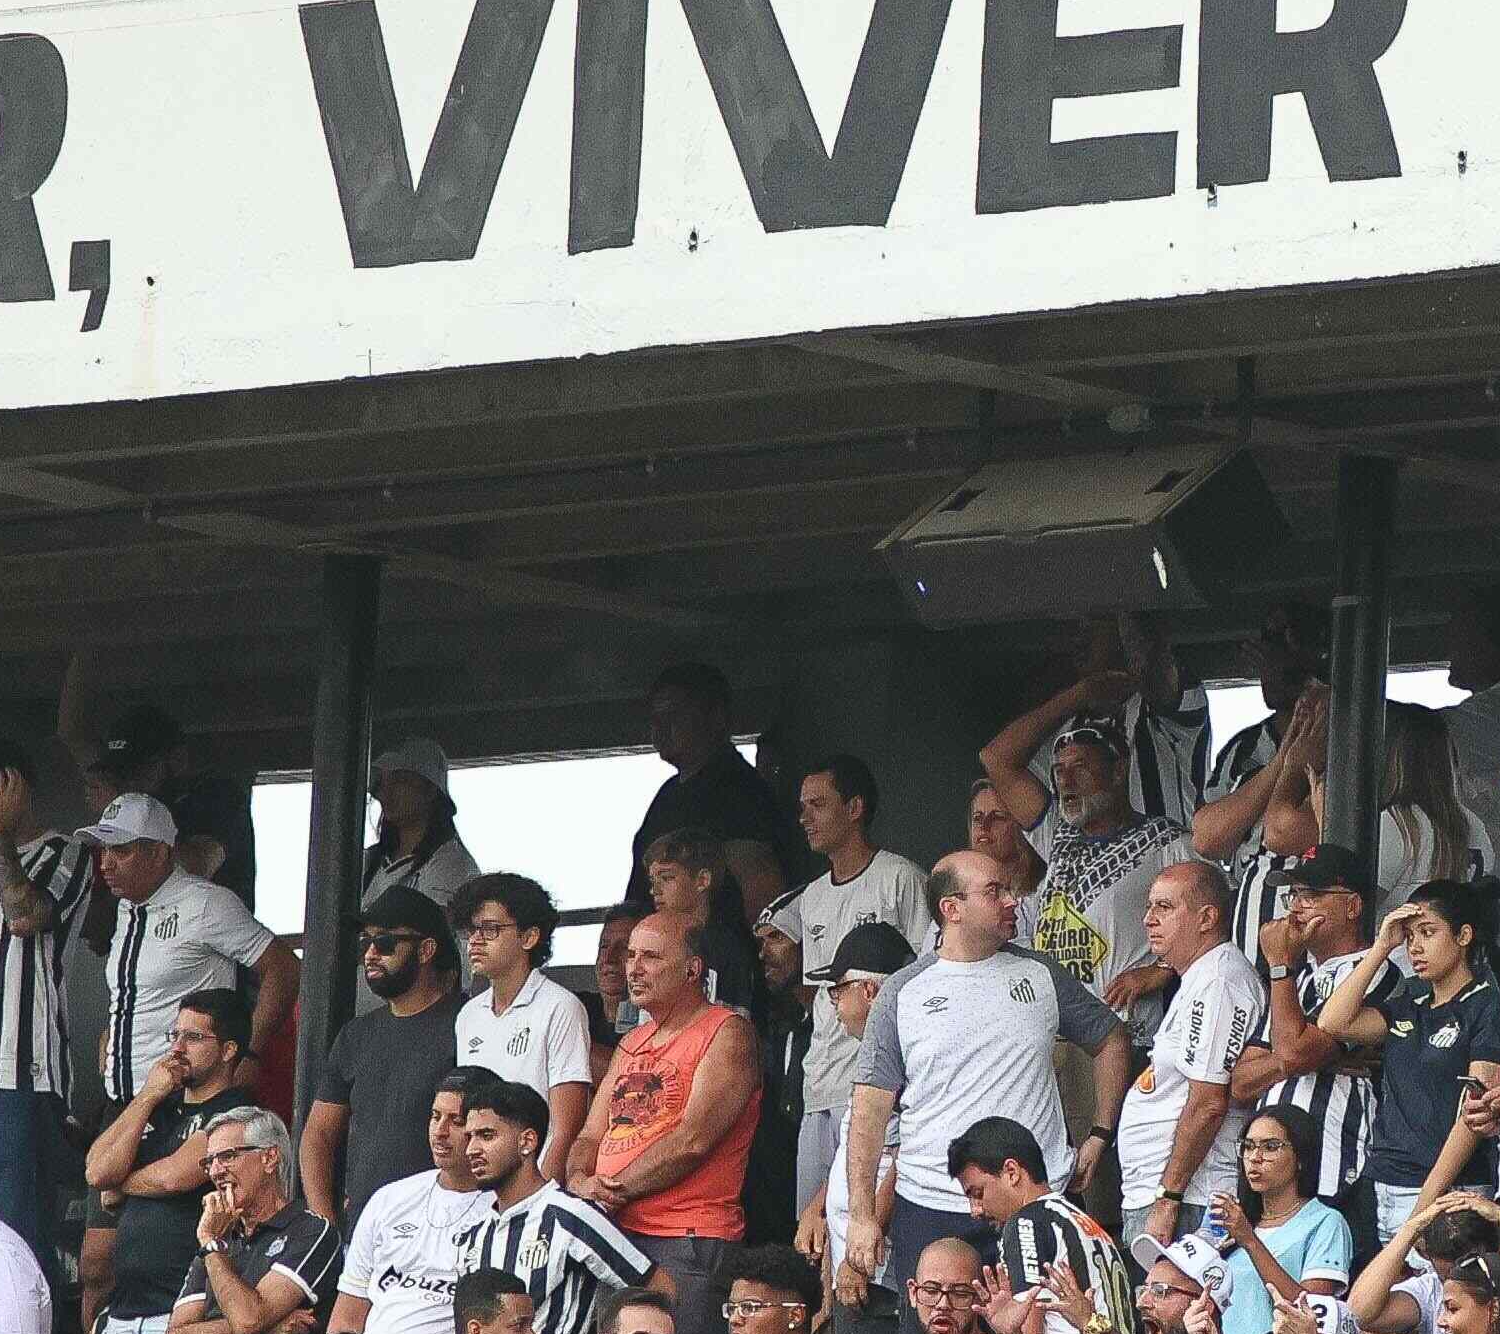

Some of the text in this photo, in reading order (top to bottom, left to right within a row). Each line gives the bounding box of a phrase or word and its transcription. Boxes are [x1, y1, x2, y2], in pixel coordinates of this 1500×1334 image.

[1182, 999, 1204, 1067] NETSHOES
[1222, 1005, 1247, 1073] NETSHOES
[1017, 1218, 1041, 1284] NETSHOES
